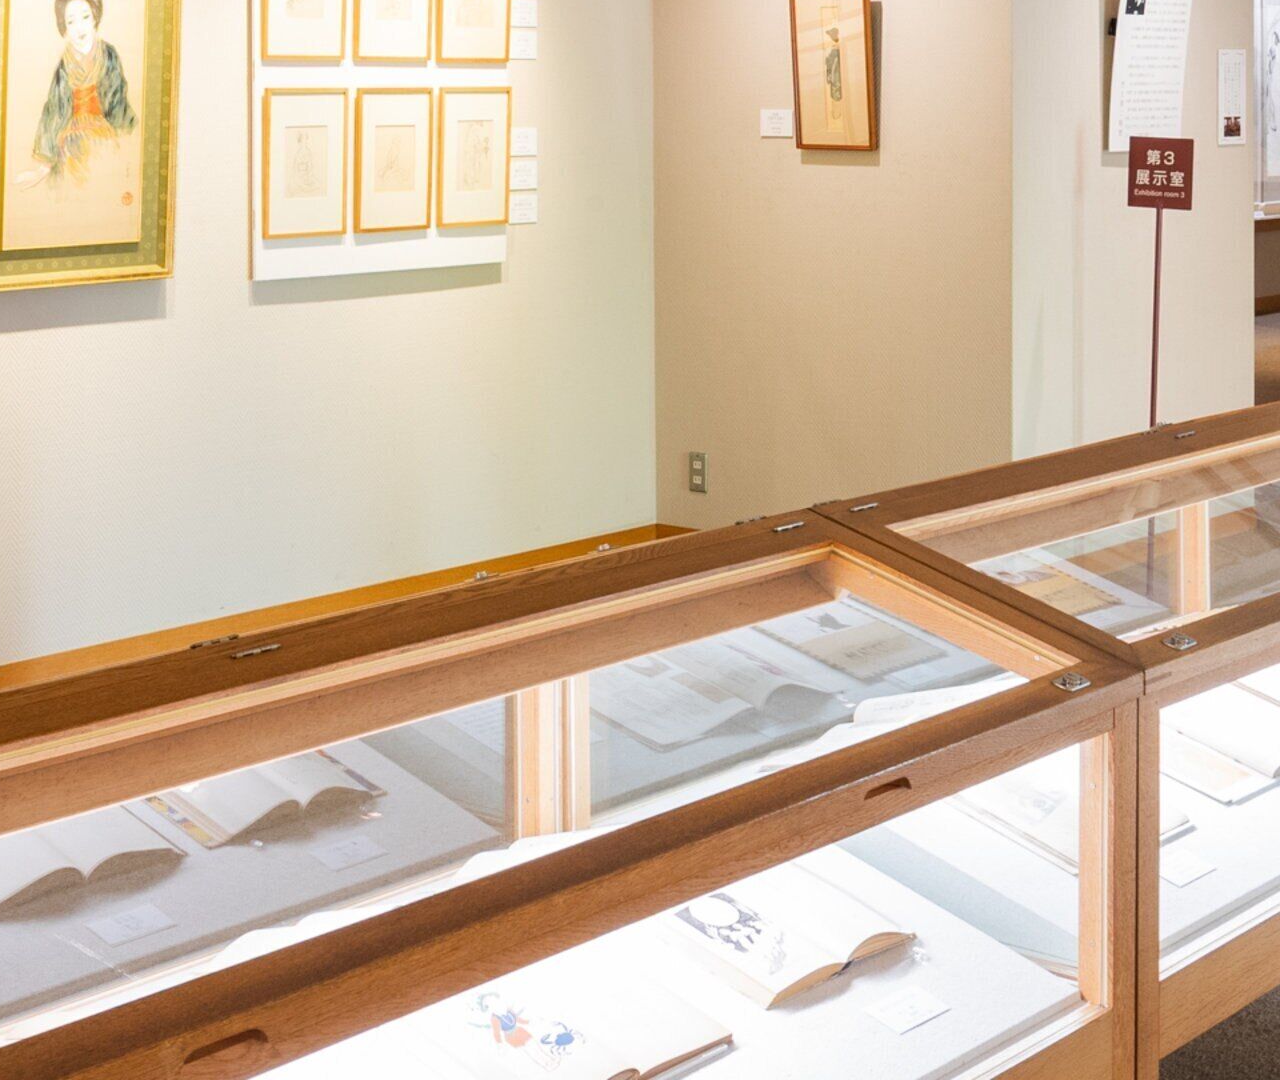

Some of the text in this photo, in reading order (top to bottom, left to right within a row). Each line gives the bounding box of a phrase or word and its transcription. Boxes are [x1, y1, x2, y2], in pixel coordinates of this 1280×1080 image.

[1146, 149, 1175, 166] 第3
[1135, 168, 1185, 187] 展示室
[1134, 188, 1163, 196] Exhibition
